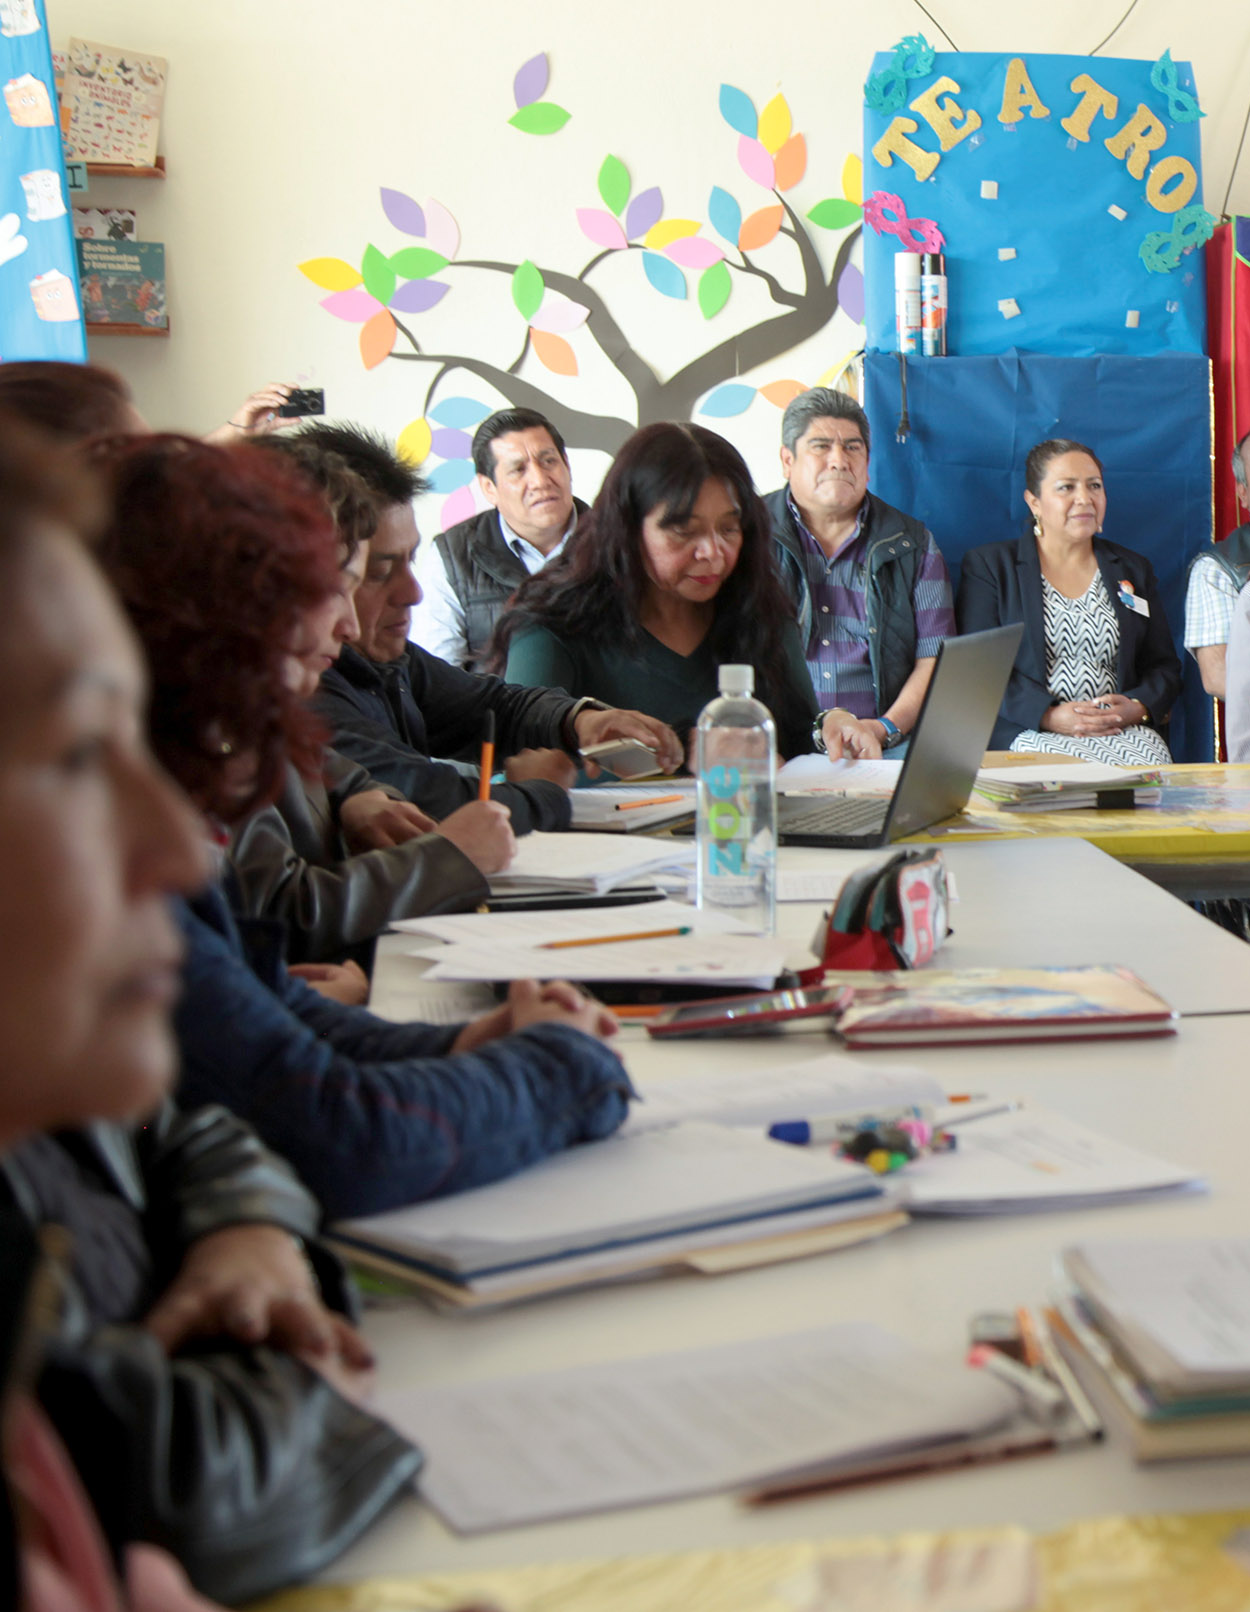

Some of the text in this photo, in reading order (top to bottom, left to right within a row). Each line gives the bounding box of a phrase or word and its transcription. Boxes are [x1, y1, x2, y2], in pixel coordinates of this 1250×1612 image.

[871, 57, 1198, 214] TEATRO
[66, 165, 83, 188] I
[82, 242, 117, 253] Sobre
[82, 252, 140, 263] tormentas
[82, 260, 142, 272] y tornados
